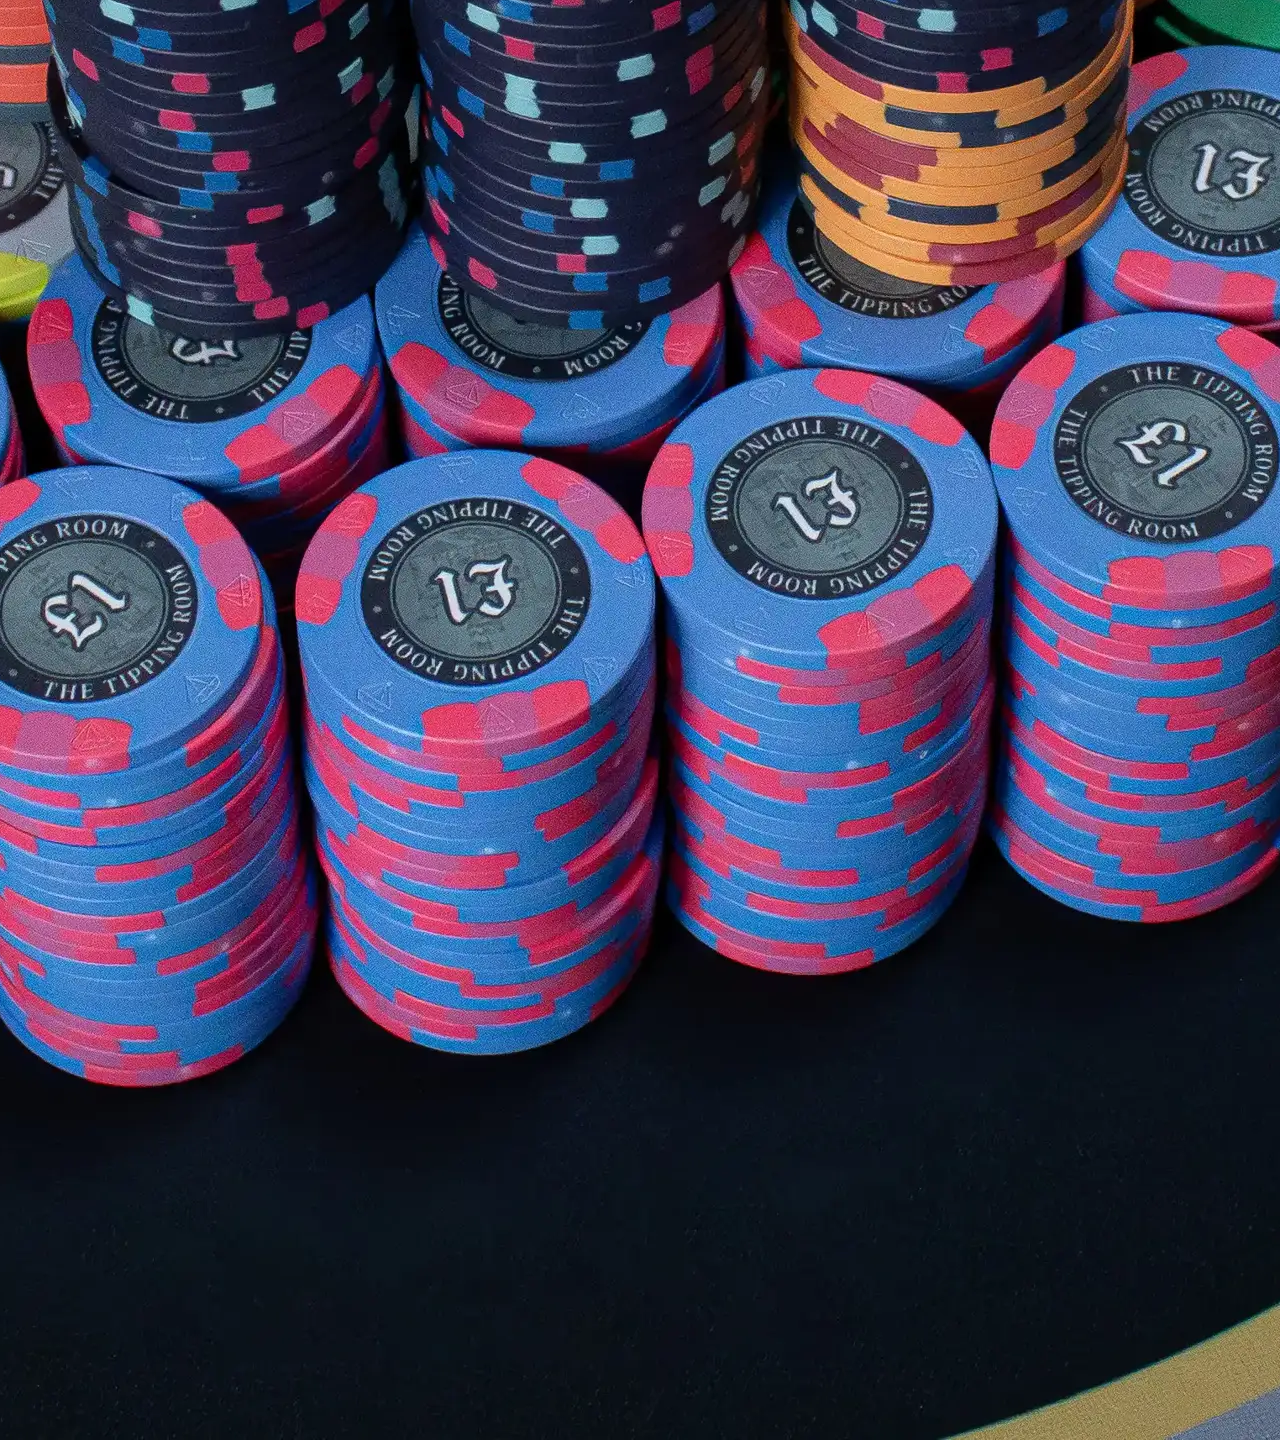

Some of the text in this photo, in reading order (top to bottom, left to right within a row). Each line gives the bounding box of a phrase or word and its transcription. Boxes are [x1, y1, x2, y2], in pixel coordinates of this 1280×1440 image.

[1143, 95, 1205, 133] ROOM
[1125, 173, 1168, 228] ROOM
[1195, 143, 1269, 200] £1
[1168, 224, 1266, 253] TIPPING
[801, 255, 936, 313] THE TIPPING
[98, 320, 187, 419] THE TIPPING
[1121, 421, 1208, 486] £1
[1130, 365, 1273, 502] THE TIPPING ROOM
[711, 420, 884, 522] THE TIPPING ROOM
[776, 471, 857, 541] £1
[1059, 407, 1201, 538] THE TIPPING ROOM
[52, 519, 130, 539] ROOM
[368, 501, 567, 582] THE TIPPING ROOM
[746, 489, 928, 595] THE TIPPING ROOM
[44, 573, 126, 648] £1
[436, 560, 514, 623] £1
[42, 562, 192, 698] THE TIPPING ROOM
[380, 597, 585, 680] THE TIPPING ROOM
